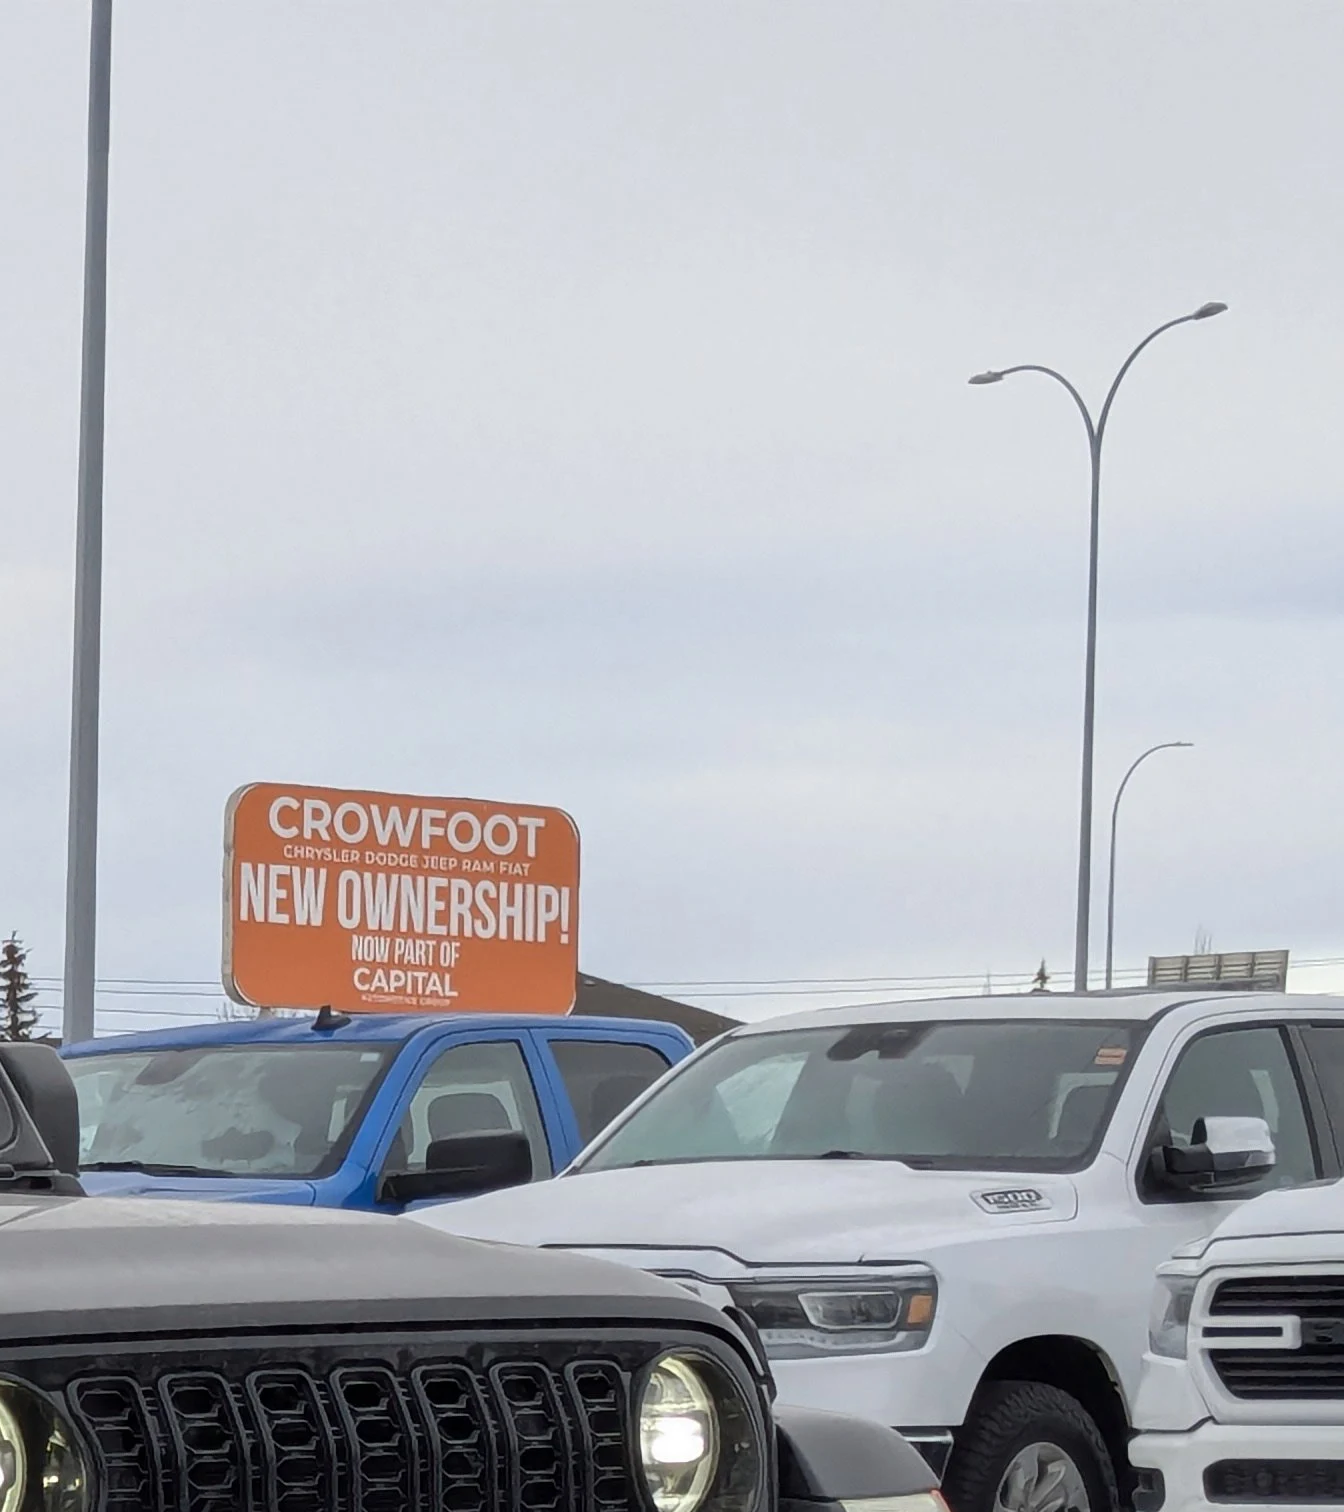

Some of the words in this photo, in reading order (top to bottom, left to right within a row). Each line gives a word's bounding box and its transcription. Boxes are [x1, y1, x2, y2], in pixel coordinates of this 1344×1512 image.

[269, 796, 546, 858] CROWFOOT
[283, 844, 361, 863] CHRYSLER
[365, 850, 419, 868] DODGE
[422, 855, 458, 871] JEEP
[461, 858, 495, 873] RAM
[499, 861, 532, 877] FIAT
[239, 862, 328, 927] NEW
[337, 869, 571, 943] OWNERSHIP!
[352, 934, 391, 963] NOW
[394, 938, 437, 966] PART
[439, 941, 461, 968] OF
[353, 967, 459, 997] CAPITAL
